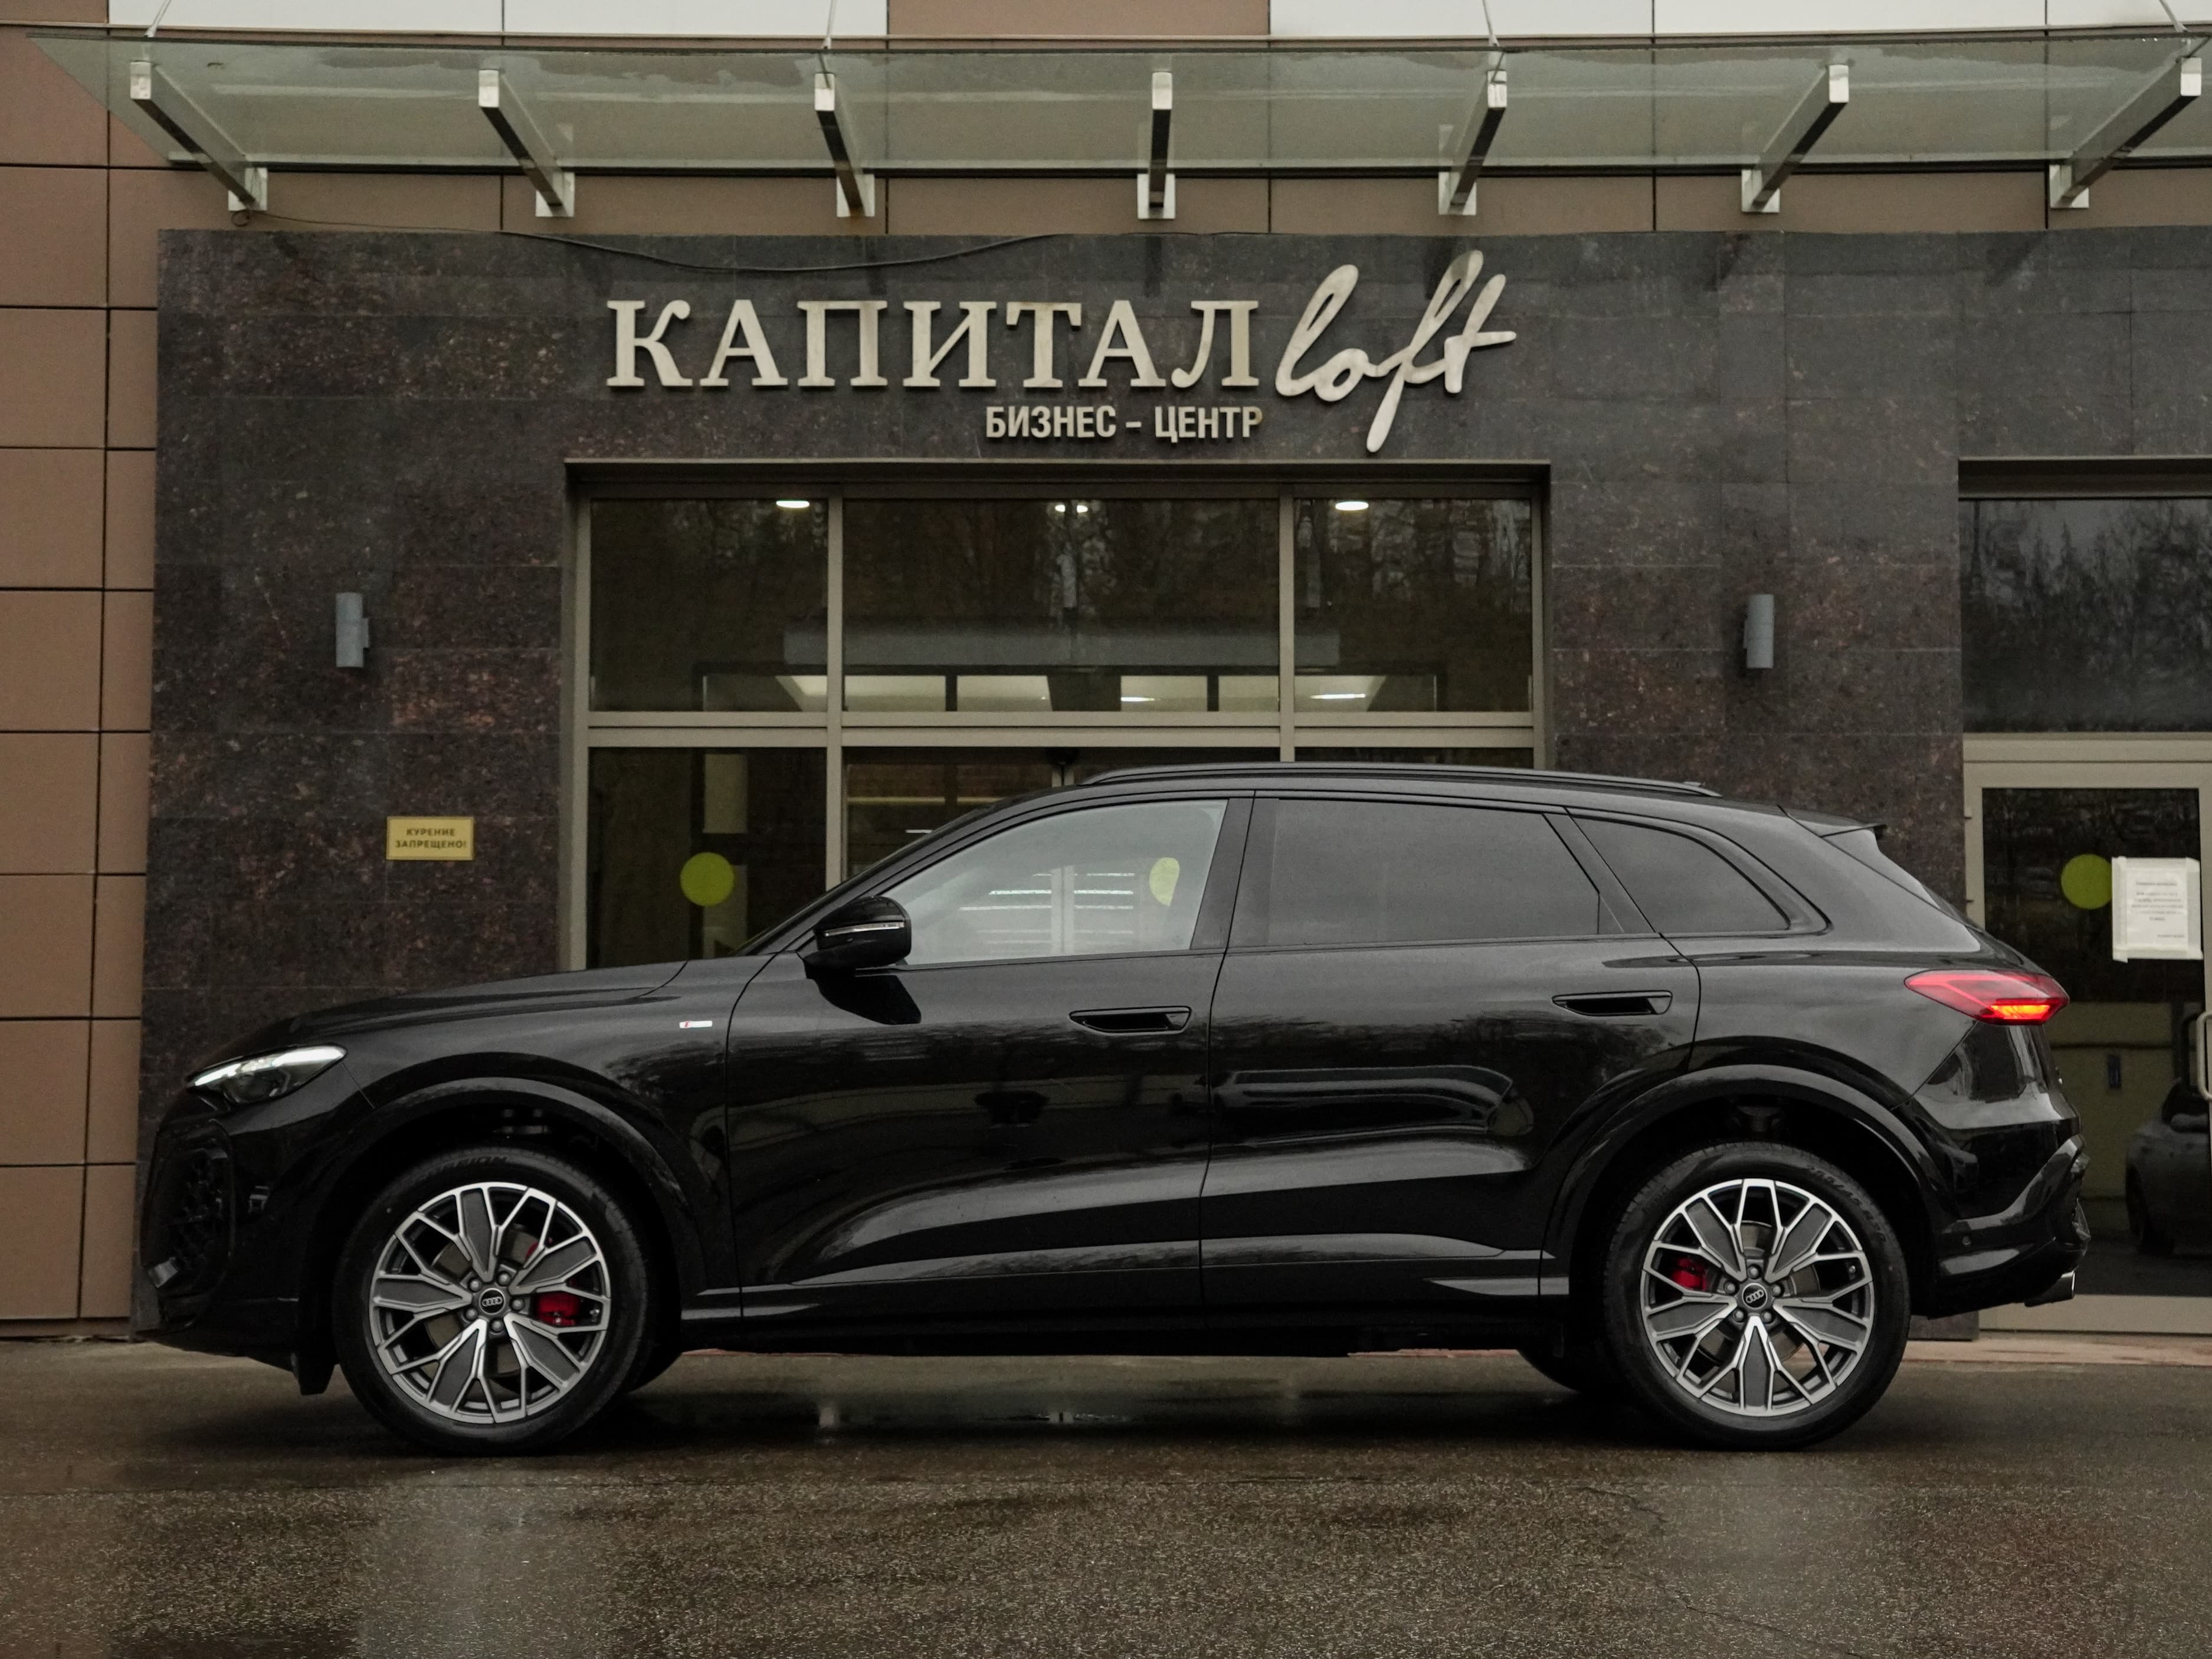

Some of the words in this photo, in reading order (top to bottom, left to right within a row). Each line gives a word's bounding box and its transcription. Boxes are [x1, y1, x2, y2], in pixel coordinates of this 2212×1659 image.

[606, 299, 1260, 388] КАПИТАЛ
[1274, 249, 1518, 453] loft
[985, 405, 1117, 439] БИЗНЕС
[1154, 405, 1263, 444] ЦЕНТР
[395, 840, 467, 849] ЗАПРЕЩЕНО!
[406, 828, 455, 837] КУРЕНИЕ
